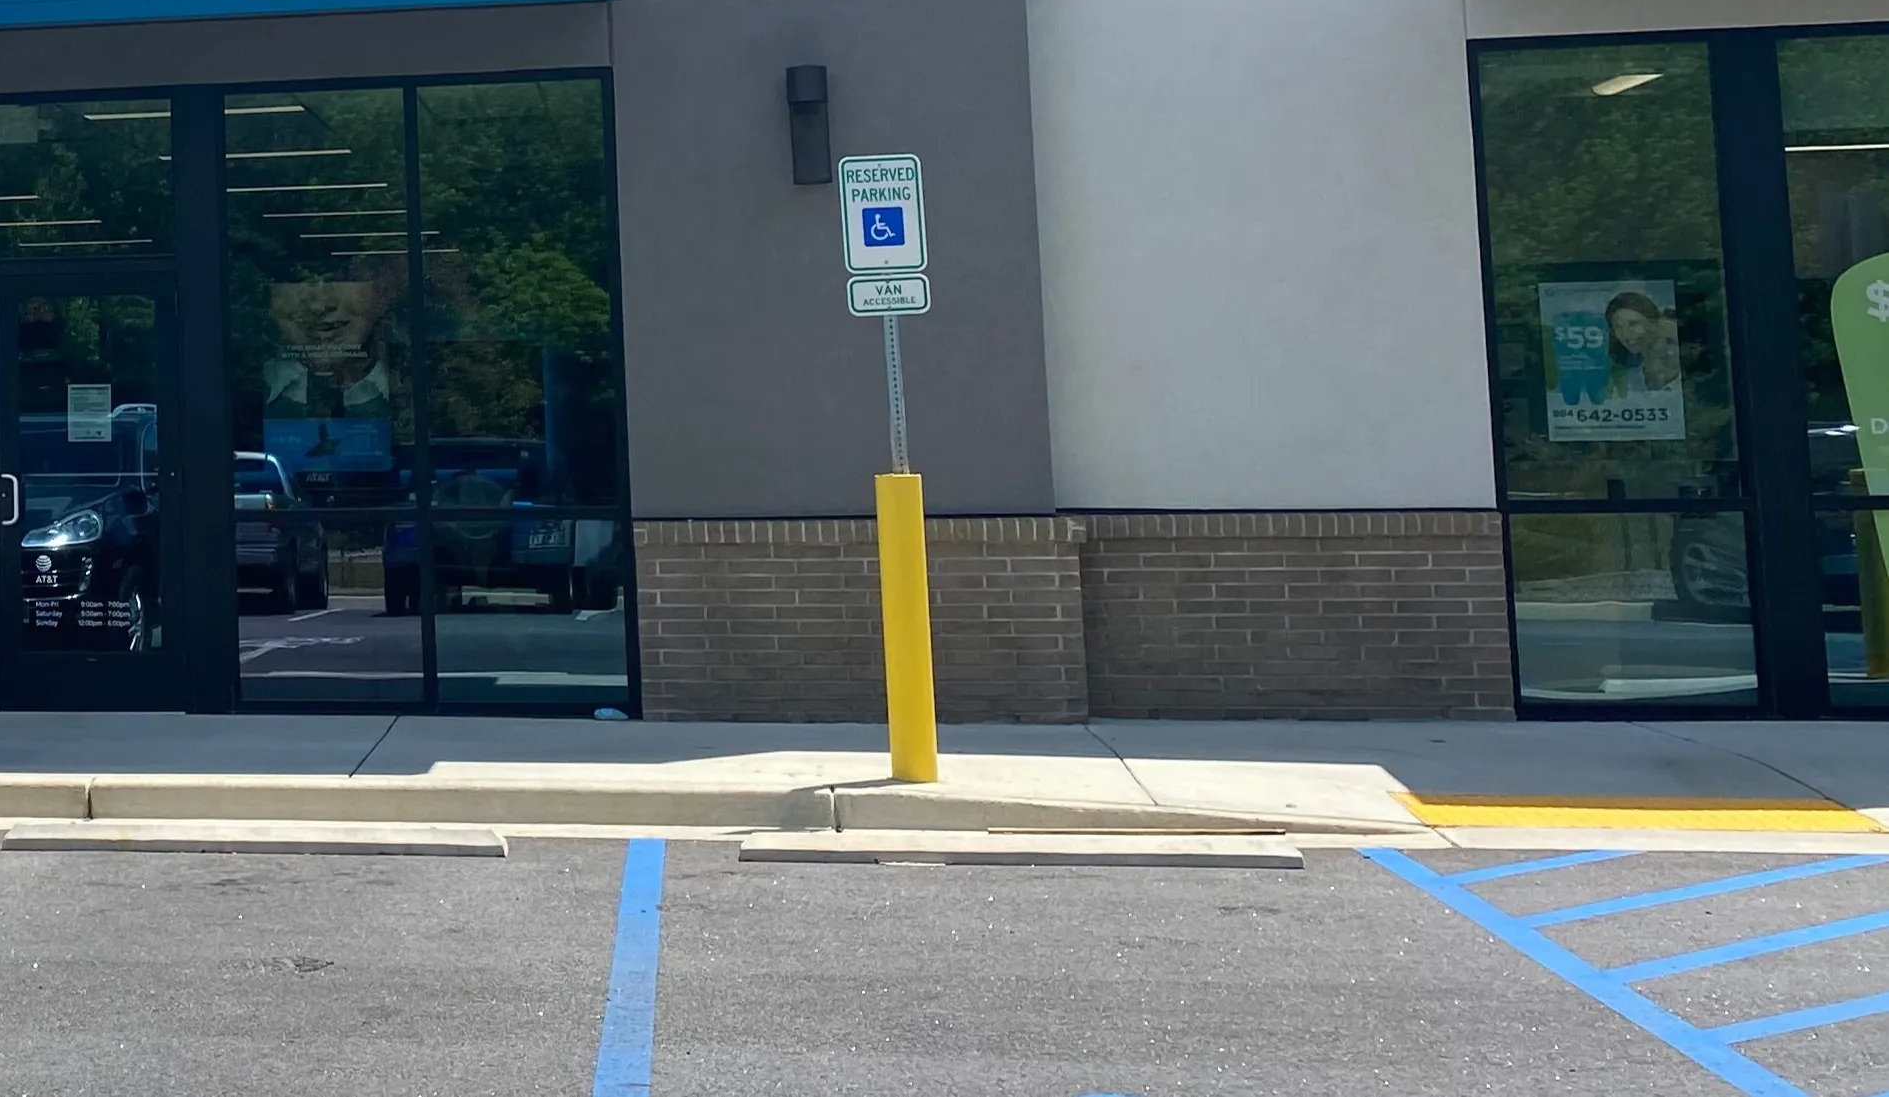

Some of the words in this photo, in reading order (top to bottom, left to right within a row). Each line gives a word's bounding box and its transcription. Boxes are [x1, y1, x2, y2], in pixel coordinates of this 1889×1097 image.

[846, 167, 915, 184] RESERVED
[851, 187, 911, 203] PARKING
[875, 284, 902, 295] VAN
[863, 296, 917, 306] ACCESSIBLE
[1554, 326, 1604, 349] $59
[1577, 407, 1669, 422] 642-0533
[306, 473, 331, 483] AT&T
[35, 575, 58, 584] AT&T
